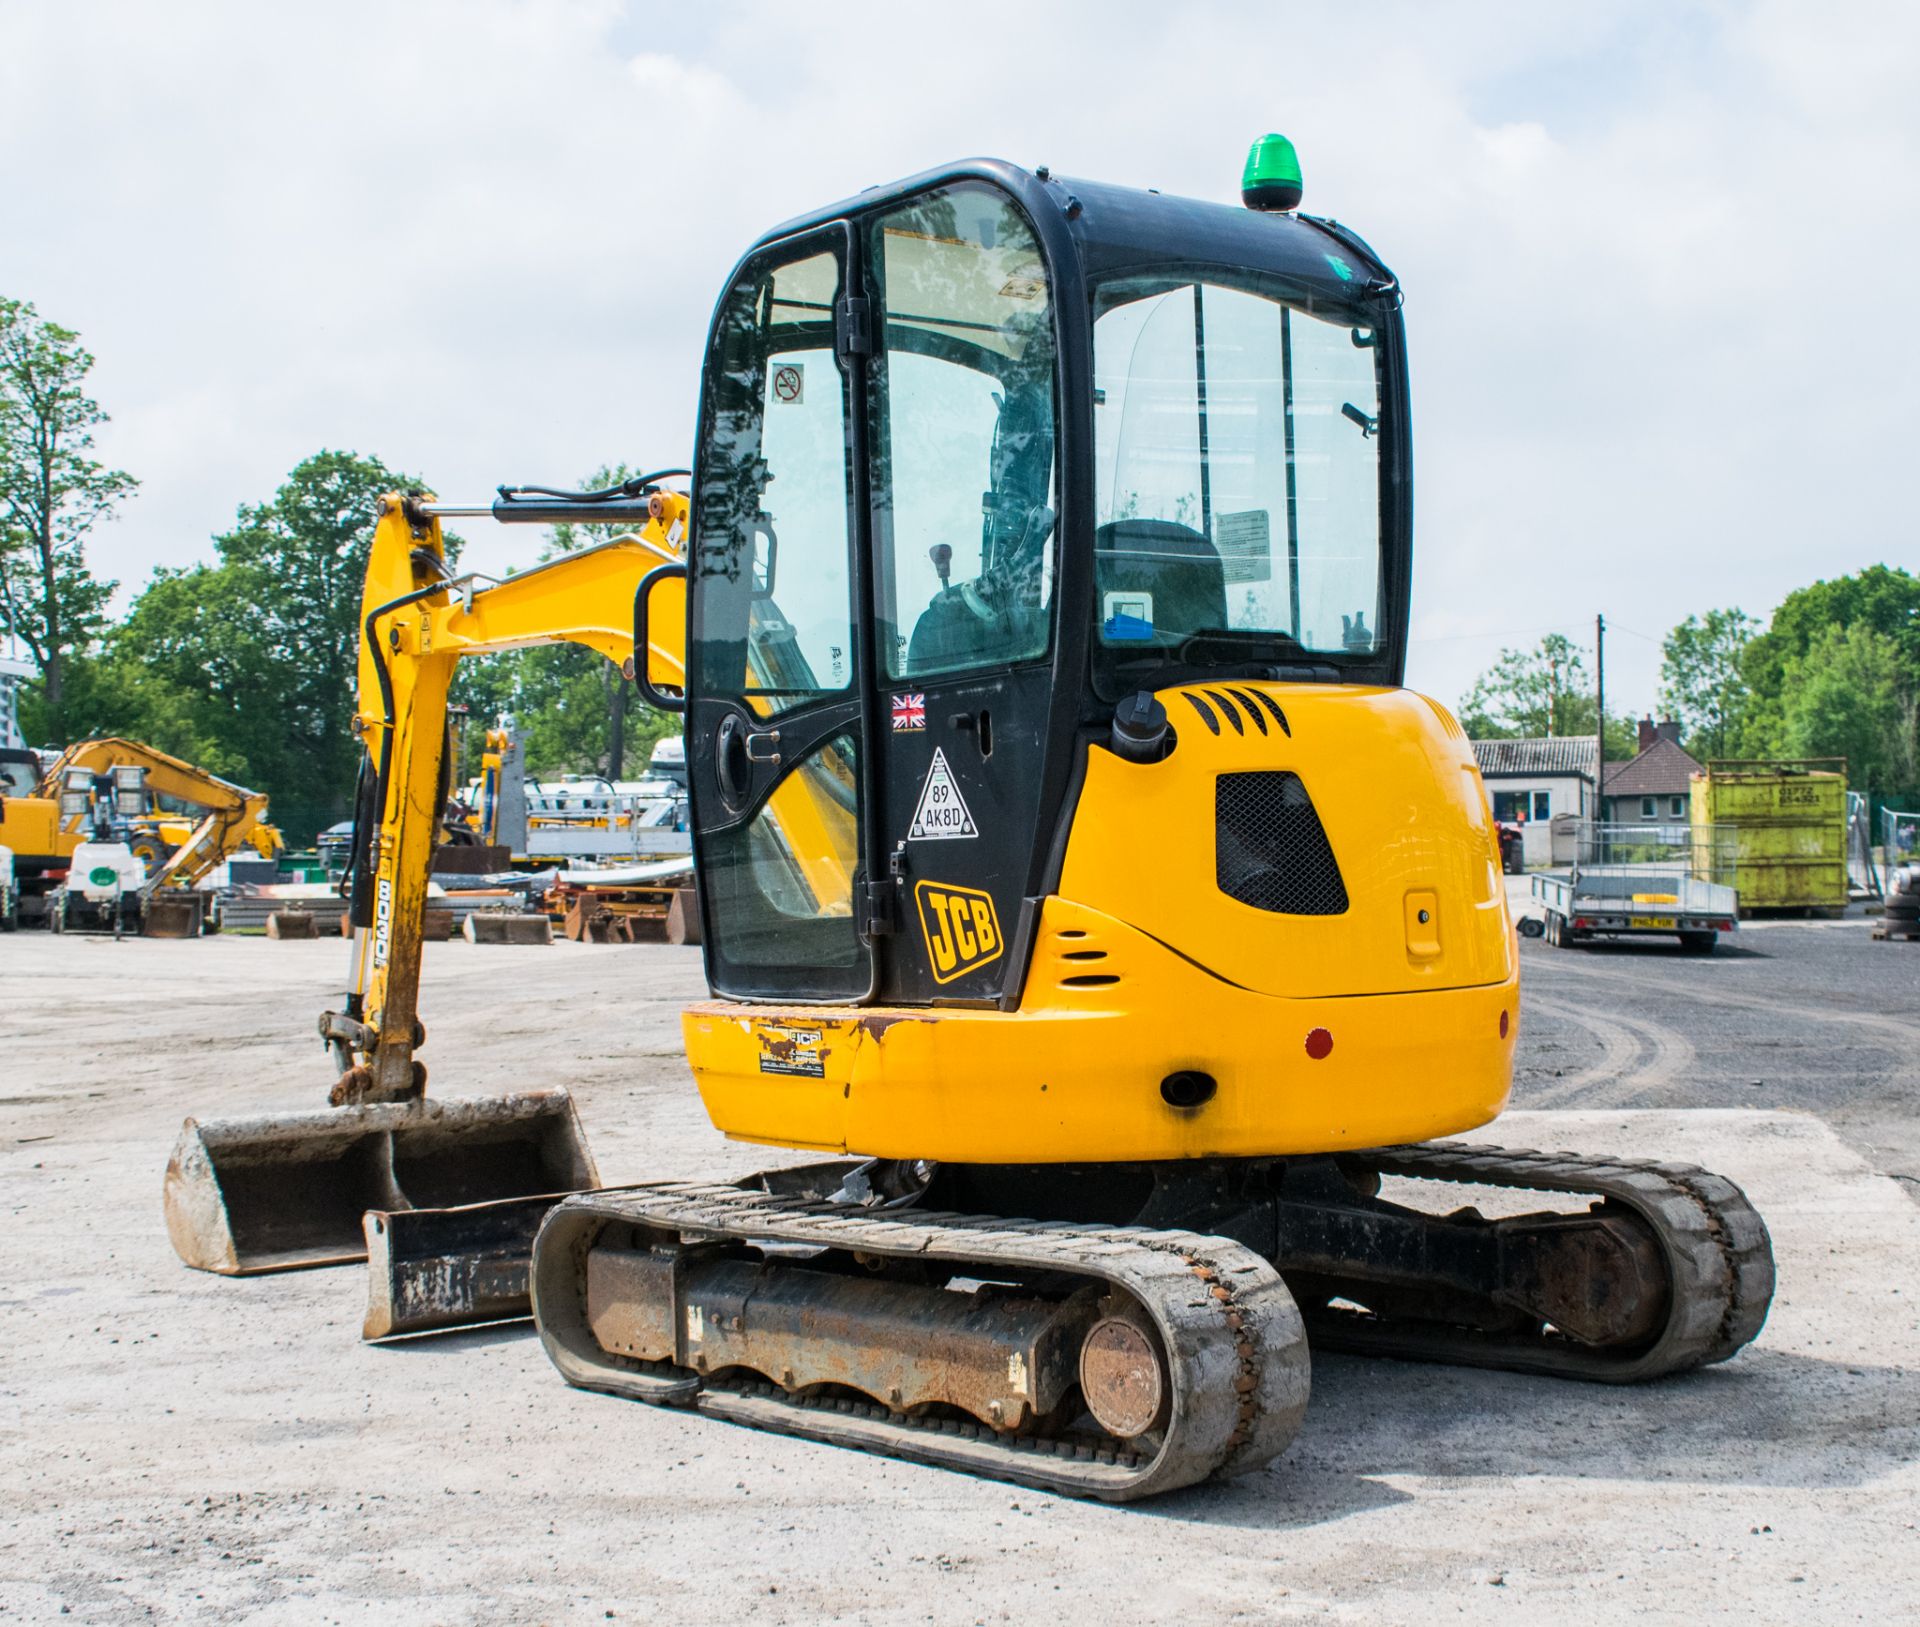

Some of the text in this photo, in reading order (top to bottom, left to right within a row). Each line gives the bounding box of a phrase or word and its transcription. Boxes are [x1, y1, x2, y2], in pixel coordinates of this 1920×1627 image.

[926, 808, 960, 827] AK8D
[933, 785, 949, 803] 89
[375, 880, 390, 960] 8030
[928, 892, 996, 971] JCB
